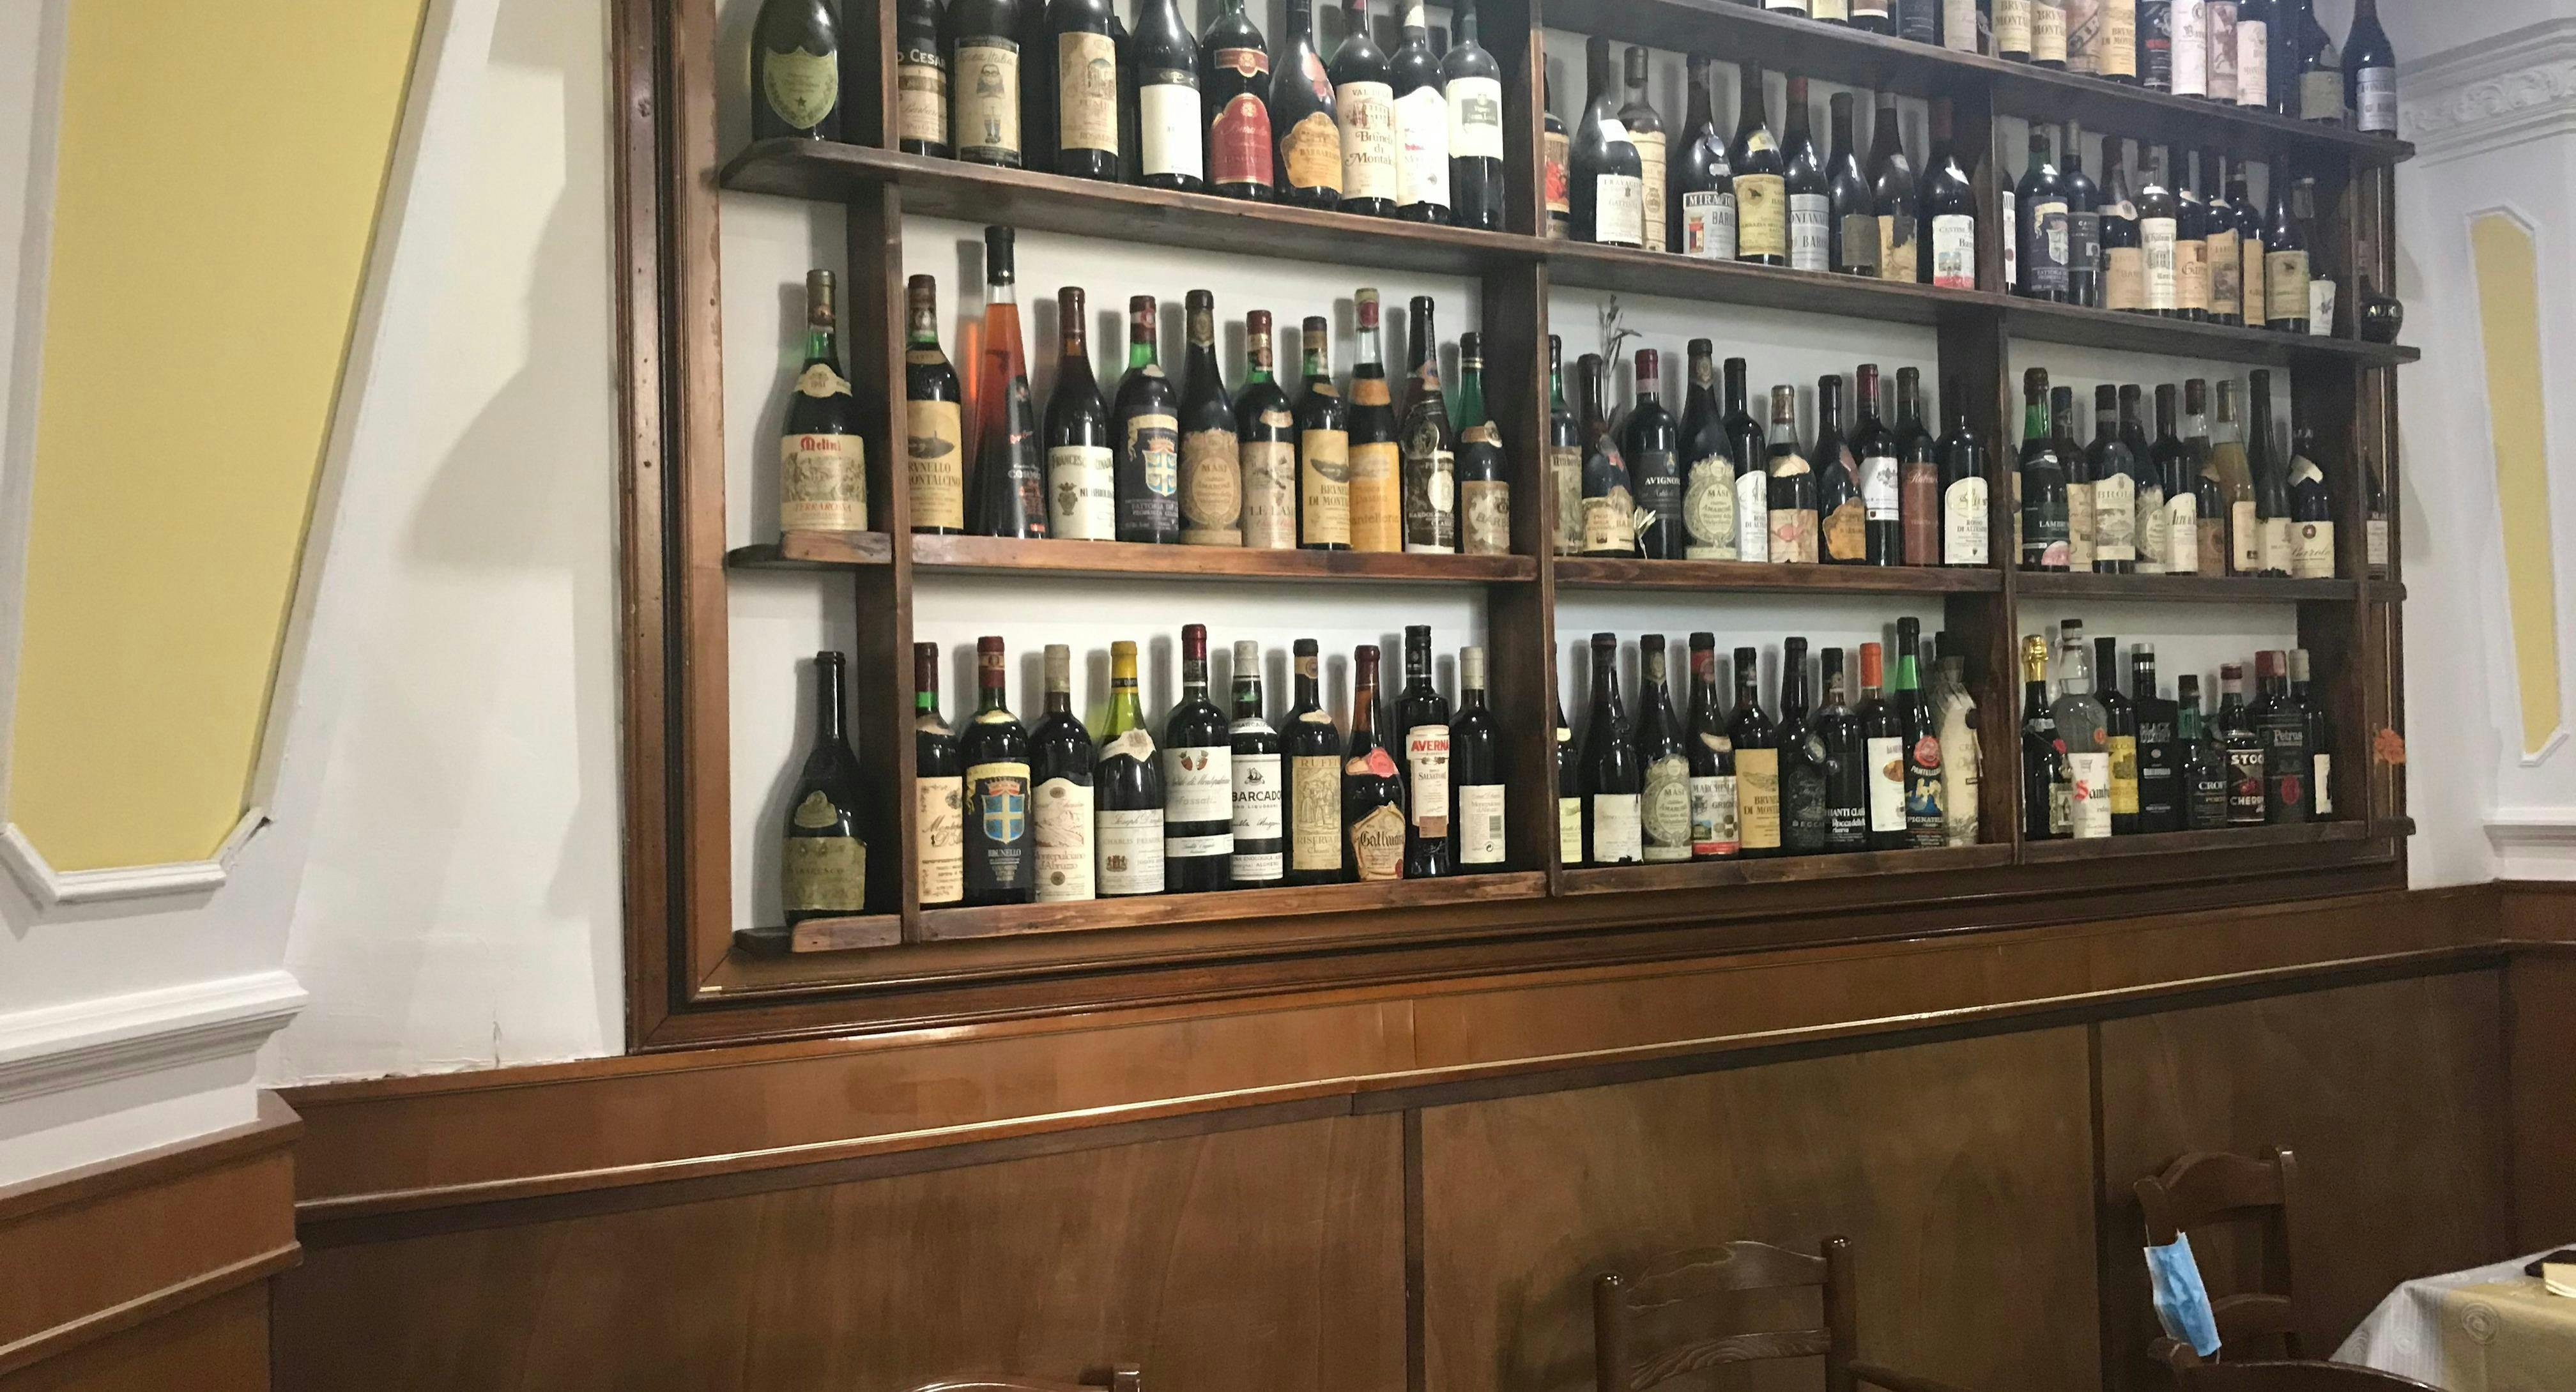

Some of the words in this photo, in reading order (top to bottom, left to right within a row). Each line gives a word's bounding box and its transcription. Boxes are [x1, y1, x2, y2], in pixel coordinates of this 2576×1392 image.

[800, 436, 842, 452] Melini
[1707, 489, 1729, 498] MASI
[1308, 494, 1319, 505] DI
[1664, 788, 1685, 797] MASI
[1742, 805, 1751, 815] DI
[988, 848, 1022, 857] BRUNELLO
